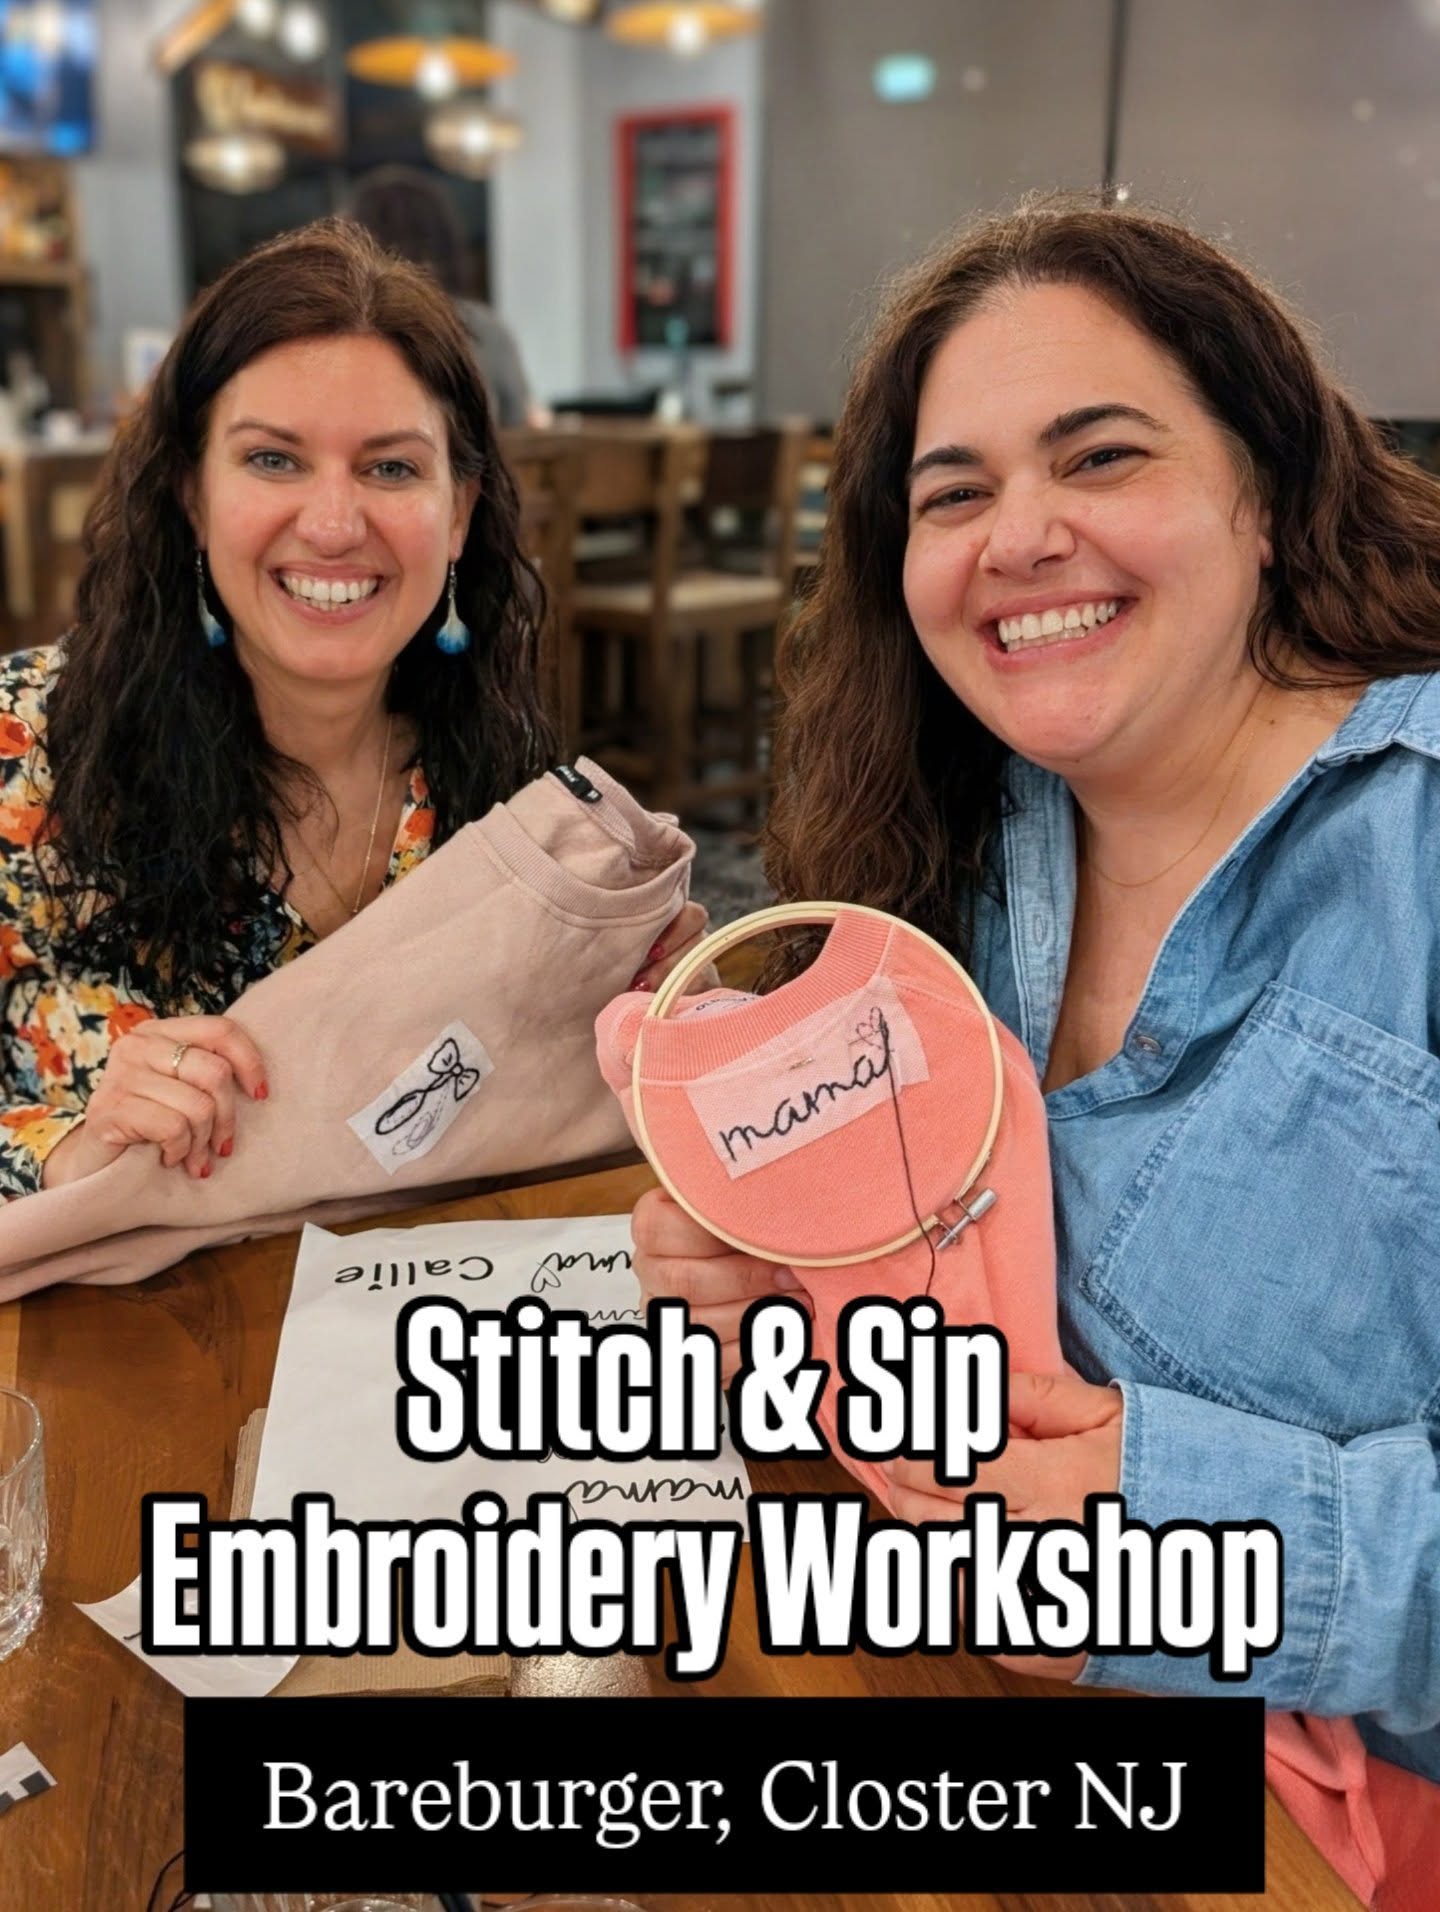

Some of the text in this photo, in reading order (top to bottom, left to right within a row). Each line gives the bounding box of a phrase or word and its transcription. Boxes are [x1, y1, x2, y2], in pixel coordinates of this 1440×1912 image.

[719, 1018, 895, 1162] mama
[334, 1256, 494, 1291] Callie
[564, 1476, 745, 1504] mama
